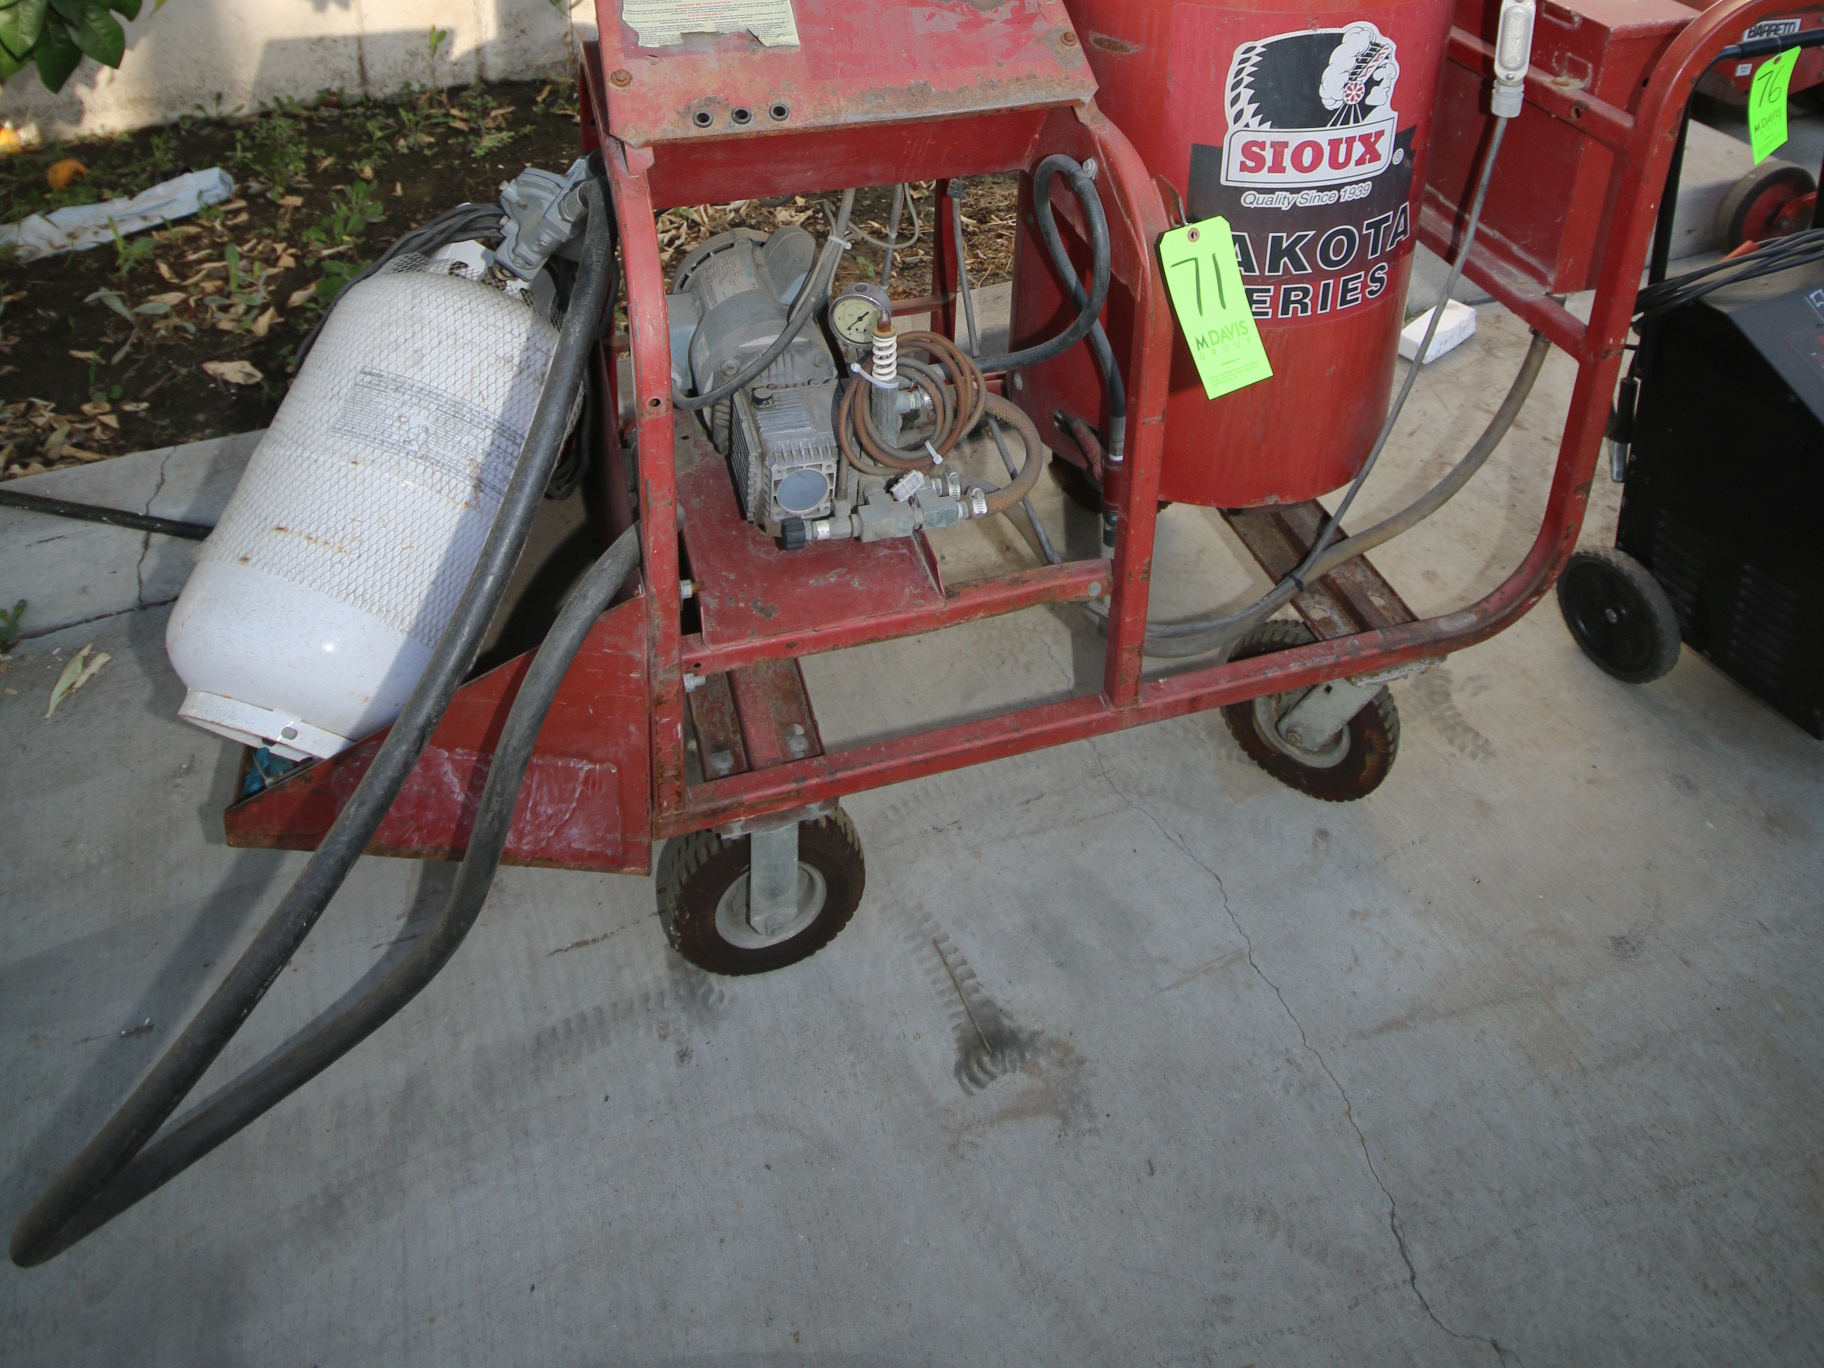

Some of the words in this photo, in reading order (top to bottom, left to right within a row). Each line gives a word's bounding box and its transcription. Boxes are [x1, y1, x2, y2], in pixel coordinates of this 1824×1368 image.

[1748, 21, 1797, 39] BARRETO
[1757, 64, 1786, 108] 76
[1239, 129, 1386, 174] SIOUX
[1242, 191, 1297, 210] Quality
[1297, 189, 1339, 207] Since
[1340, 181, 1373, 203] 1939
[1231, 201, 1410, 276] AKOTA
[1170, 252, 1227, 317] 71
[1244, 262, 1389, 319] ERIES
